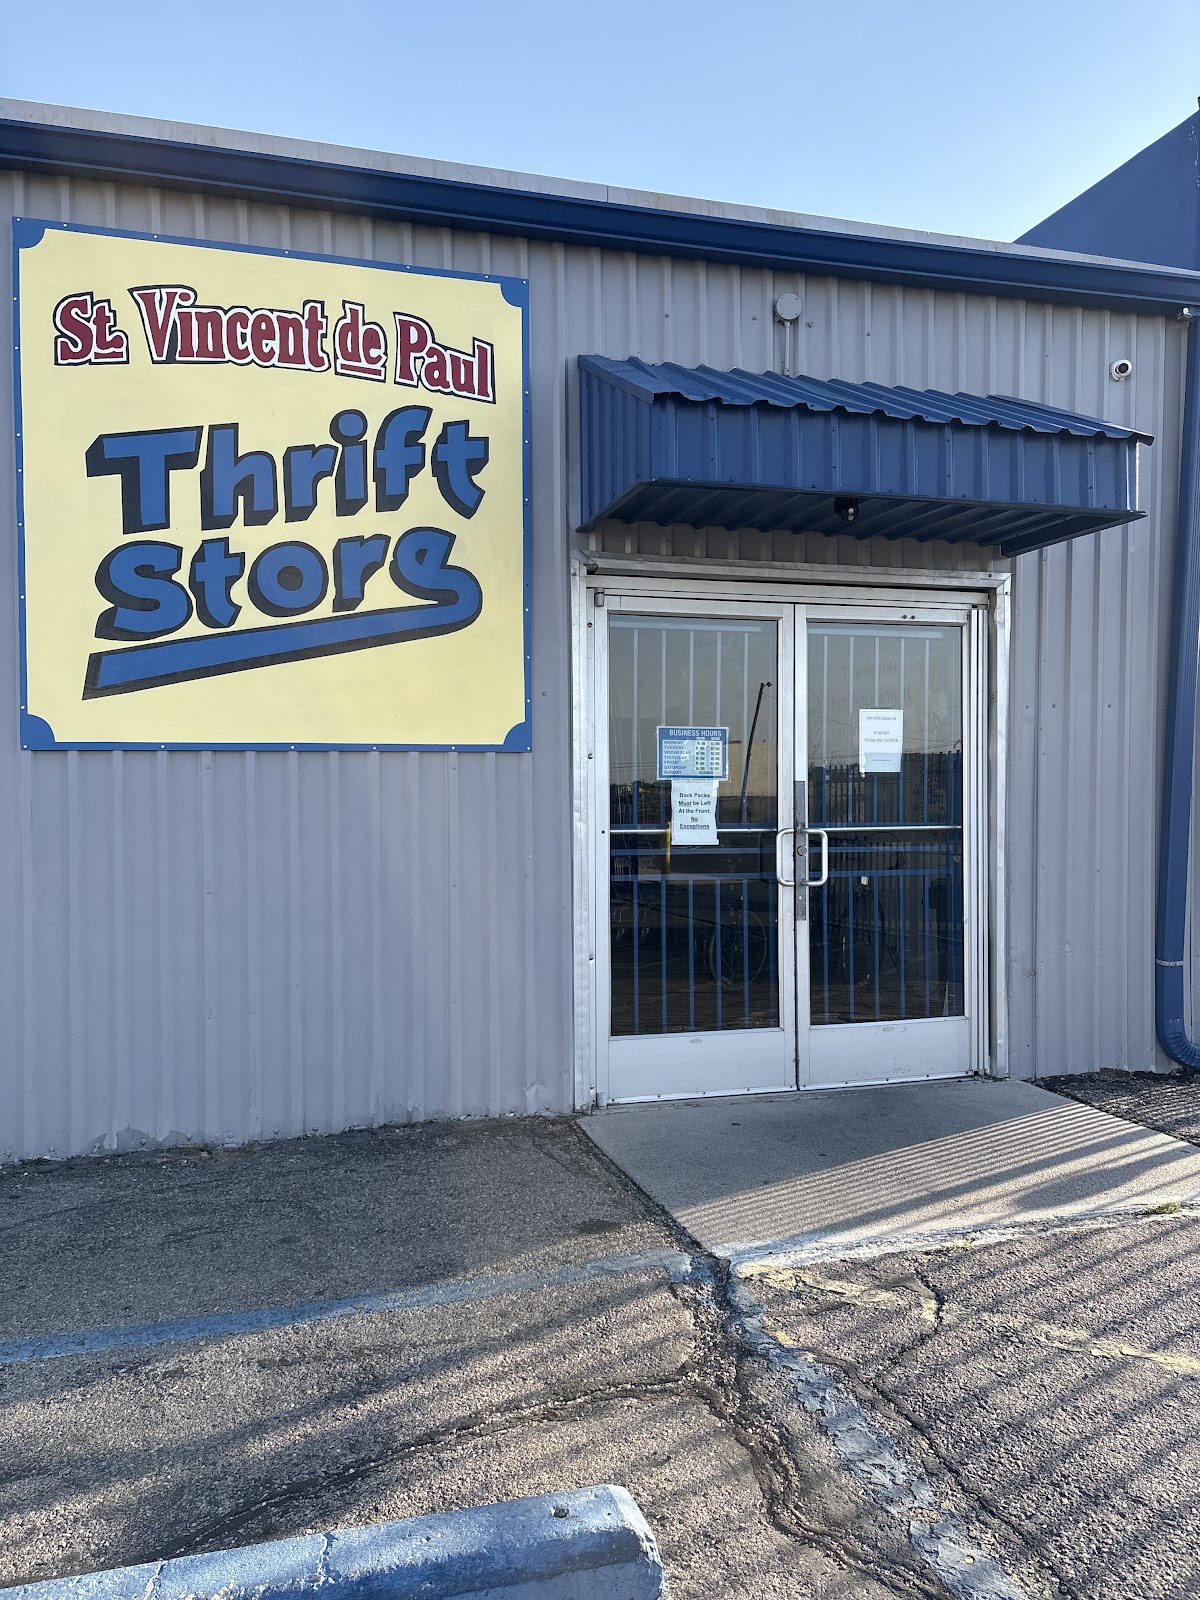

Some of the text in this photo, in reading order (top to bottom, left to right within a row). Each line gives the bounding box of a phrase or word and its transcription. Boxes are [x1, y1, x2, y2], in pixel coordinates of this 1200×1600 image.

[127, 284, 331, 372] Vincent
[334, 300, 388, 382] de
[393, 312, 496, 404] Paul
[85, 404, 490, 535] Thrift
[94, 526, 484, 645] Store
[669, 729, 700, 737] BUSINESS
[701, 730, 722, 738] HOURS
